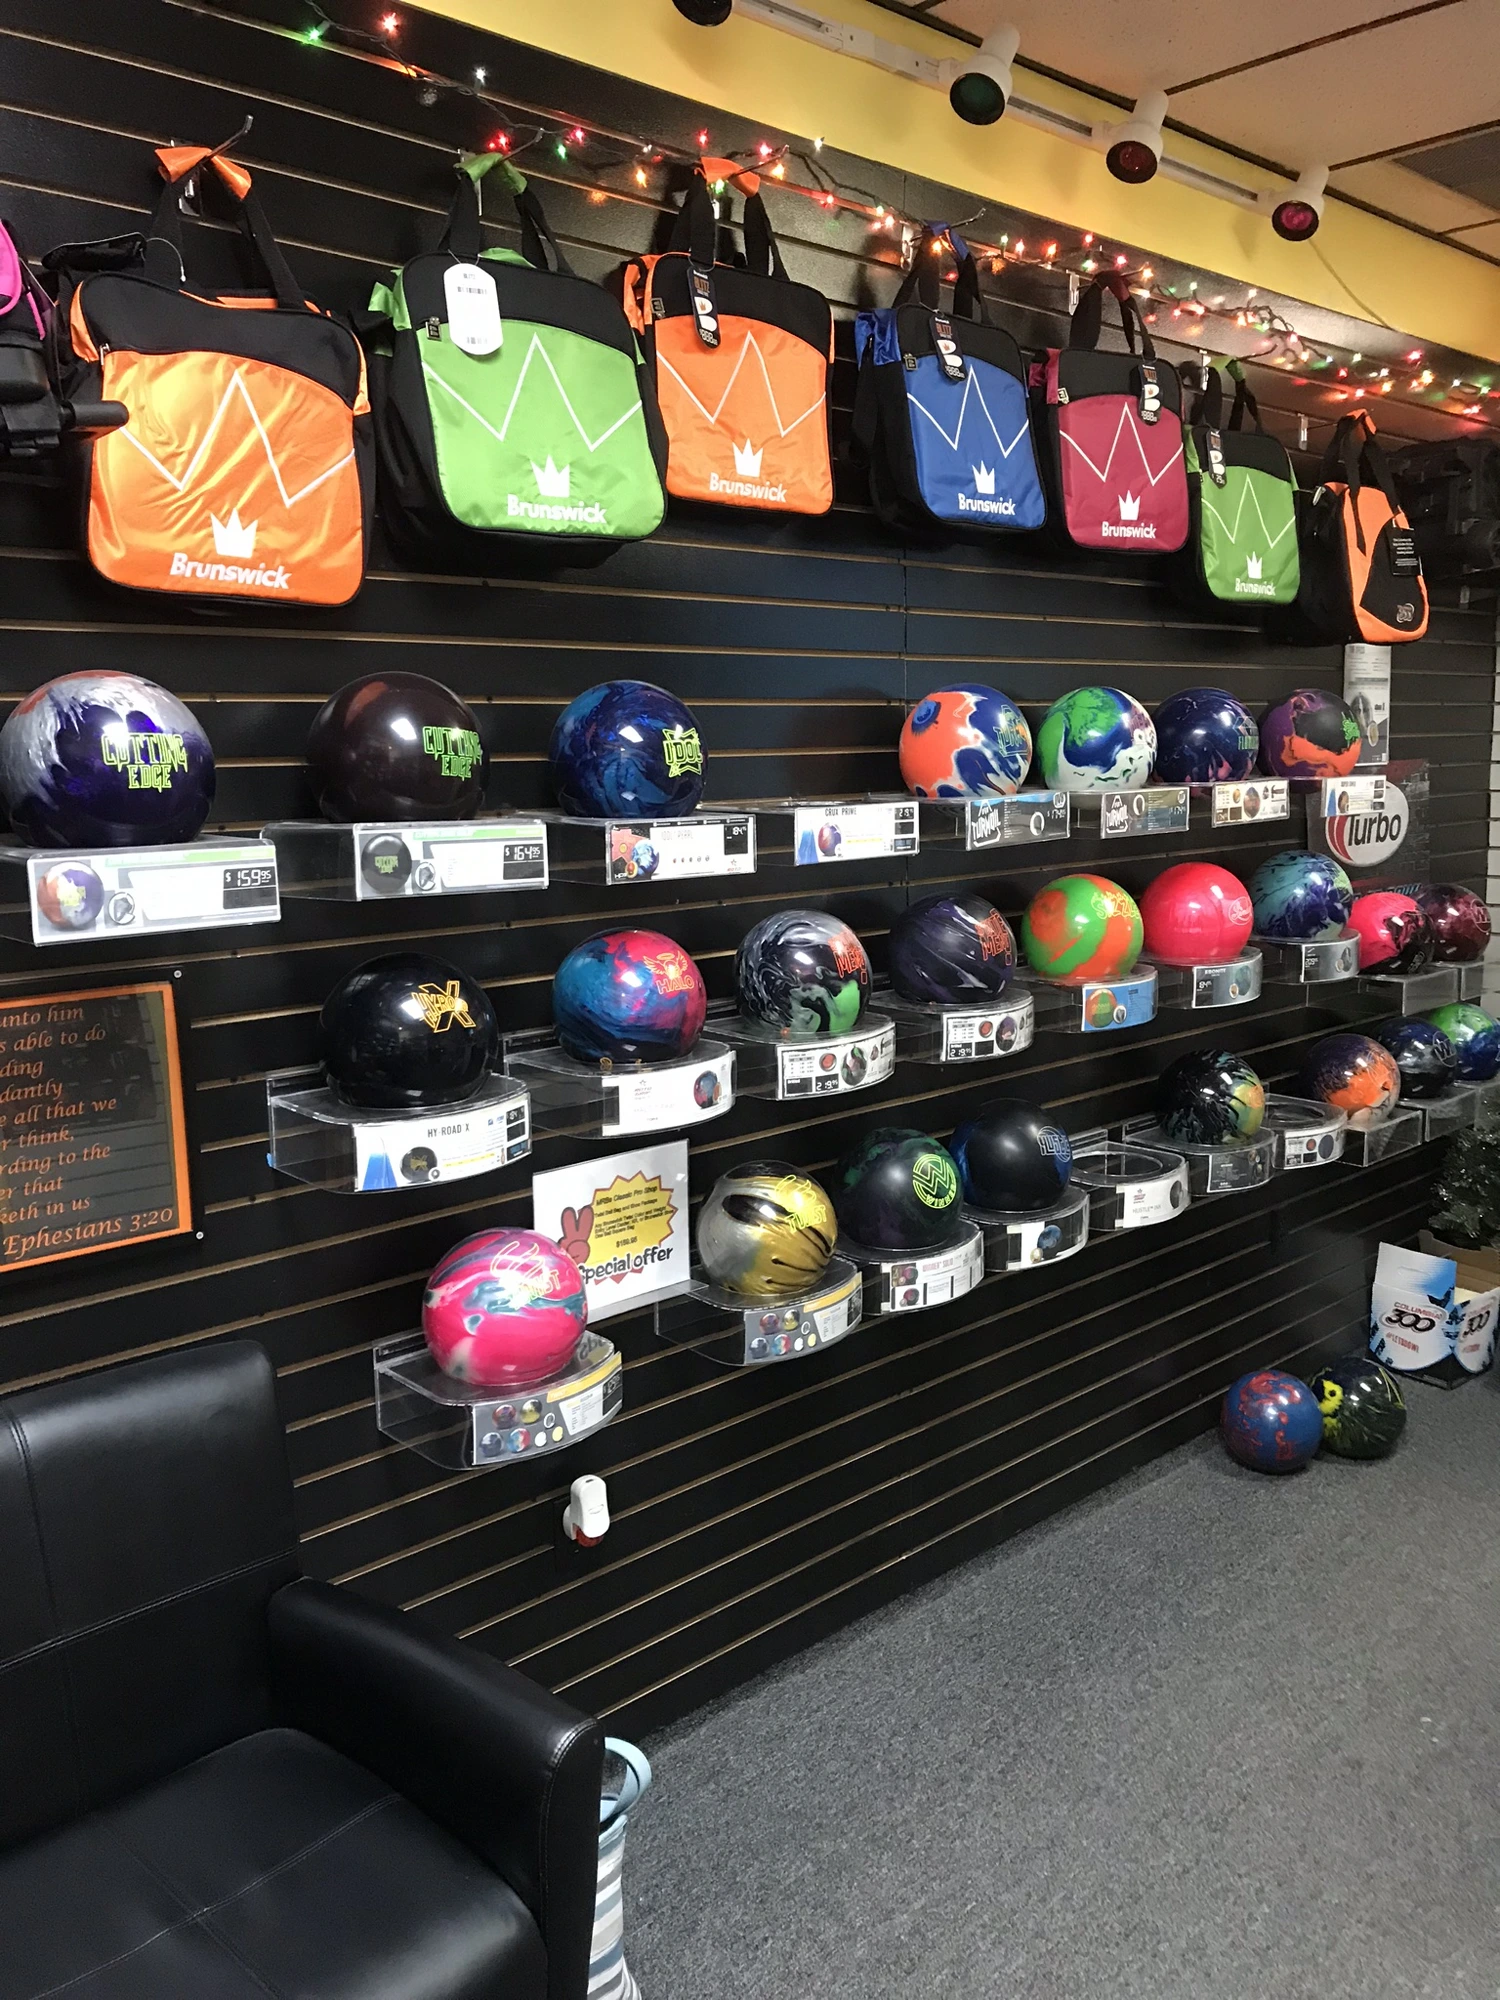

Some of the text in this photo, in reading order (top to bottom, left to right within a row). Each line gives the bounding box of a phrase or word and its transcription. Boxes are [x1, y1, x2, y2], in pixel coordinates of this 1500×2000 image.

[709, 472, 788, 503] Brunswick
[507, 493, 607, 525] Brunswick
[957, 493, 1016, 516] Brunswick
[1102, 521, 1157, 539] Brunswick
[169, 552, 292, 590] Brunswick
[1235, 578, 1276, 597] Brunswick
[101, 733, 188, 773] CUTTING
[422, 726, 482, 765] CUTTING
[663, 740, 703, 766] IDOL
[128, 765, 172, 792] EDGE
[441, 755, 472, 781] EDGE
[825, 808, 839, 817] CRUX
[1348, 812, 1401, 847] Turbo
[656, 975, 694, 994] HALO
[0, 1005, 84, 1028] unto him
[13, 1030, 53, 1051] able
[60, 1031, 78, 1045] to
[85, 1023, 106, 1041] do
[0, 1059, 43, 1079] ding
[0, 1078, 63, 1103] dantly
[14, 1104, 42, 1125] all
[46, 1101, 85, 1120] that
[92, 1098, 117, 1112] we
[19, 1124, 75, 1148] think,
[58, 1151, 76, 1166] to
[83, 1143, 111, 1161] the
[23, 1176, 64, 1196] that
[46, 1202, 64, 1215] in
[71, 1196, 91, 1211] us
[2, 1208, 173, 1260] Ephesians 3:20
[578, 1246, 673, 1284] Special offer
[1385, 1308, 1436, 1332] 300
[1394, 1301, 1442, 1320] COLUMBIA
